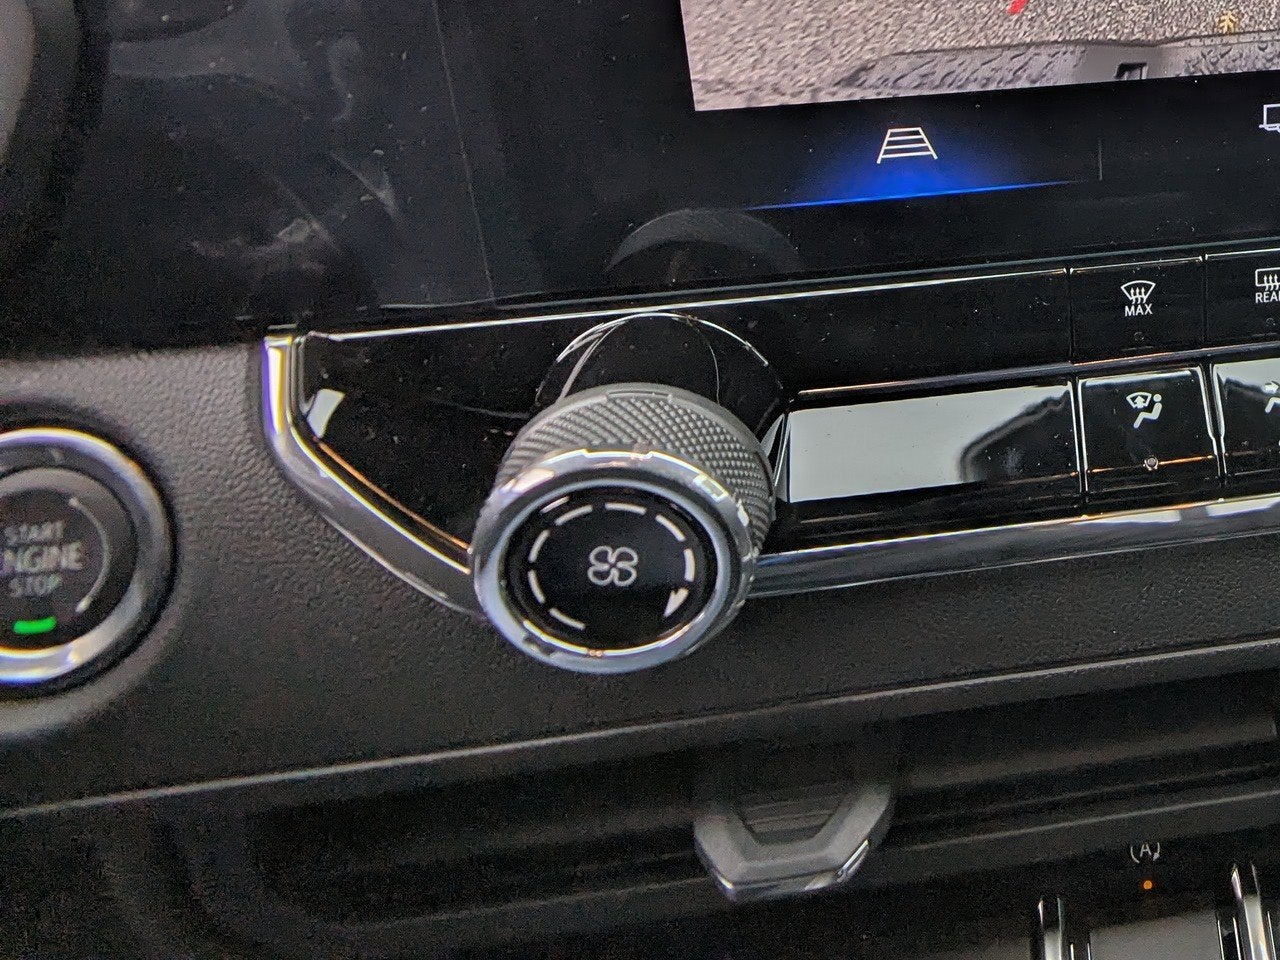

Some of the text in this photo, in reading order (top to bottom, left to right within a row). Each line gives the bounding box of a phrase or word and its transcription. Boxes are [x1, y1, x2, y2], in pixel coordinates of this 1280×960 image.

[1124, 304, 1153, 317] MAX
[4, 520, 66, 546] START
[0, 542, 83, 576] NGINE
[8, 573, 63, 598] STOP
